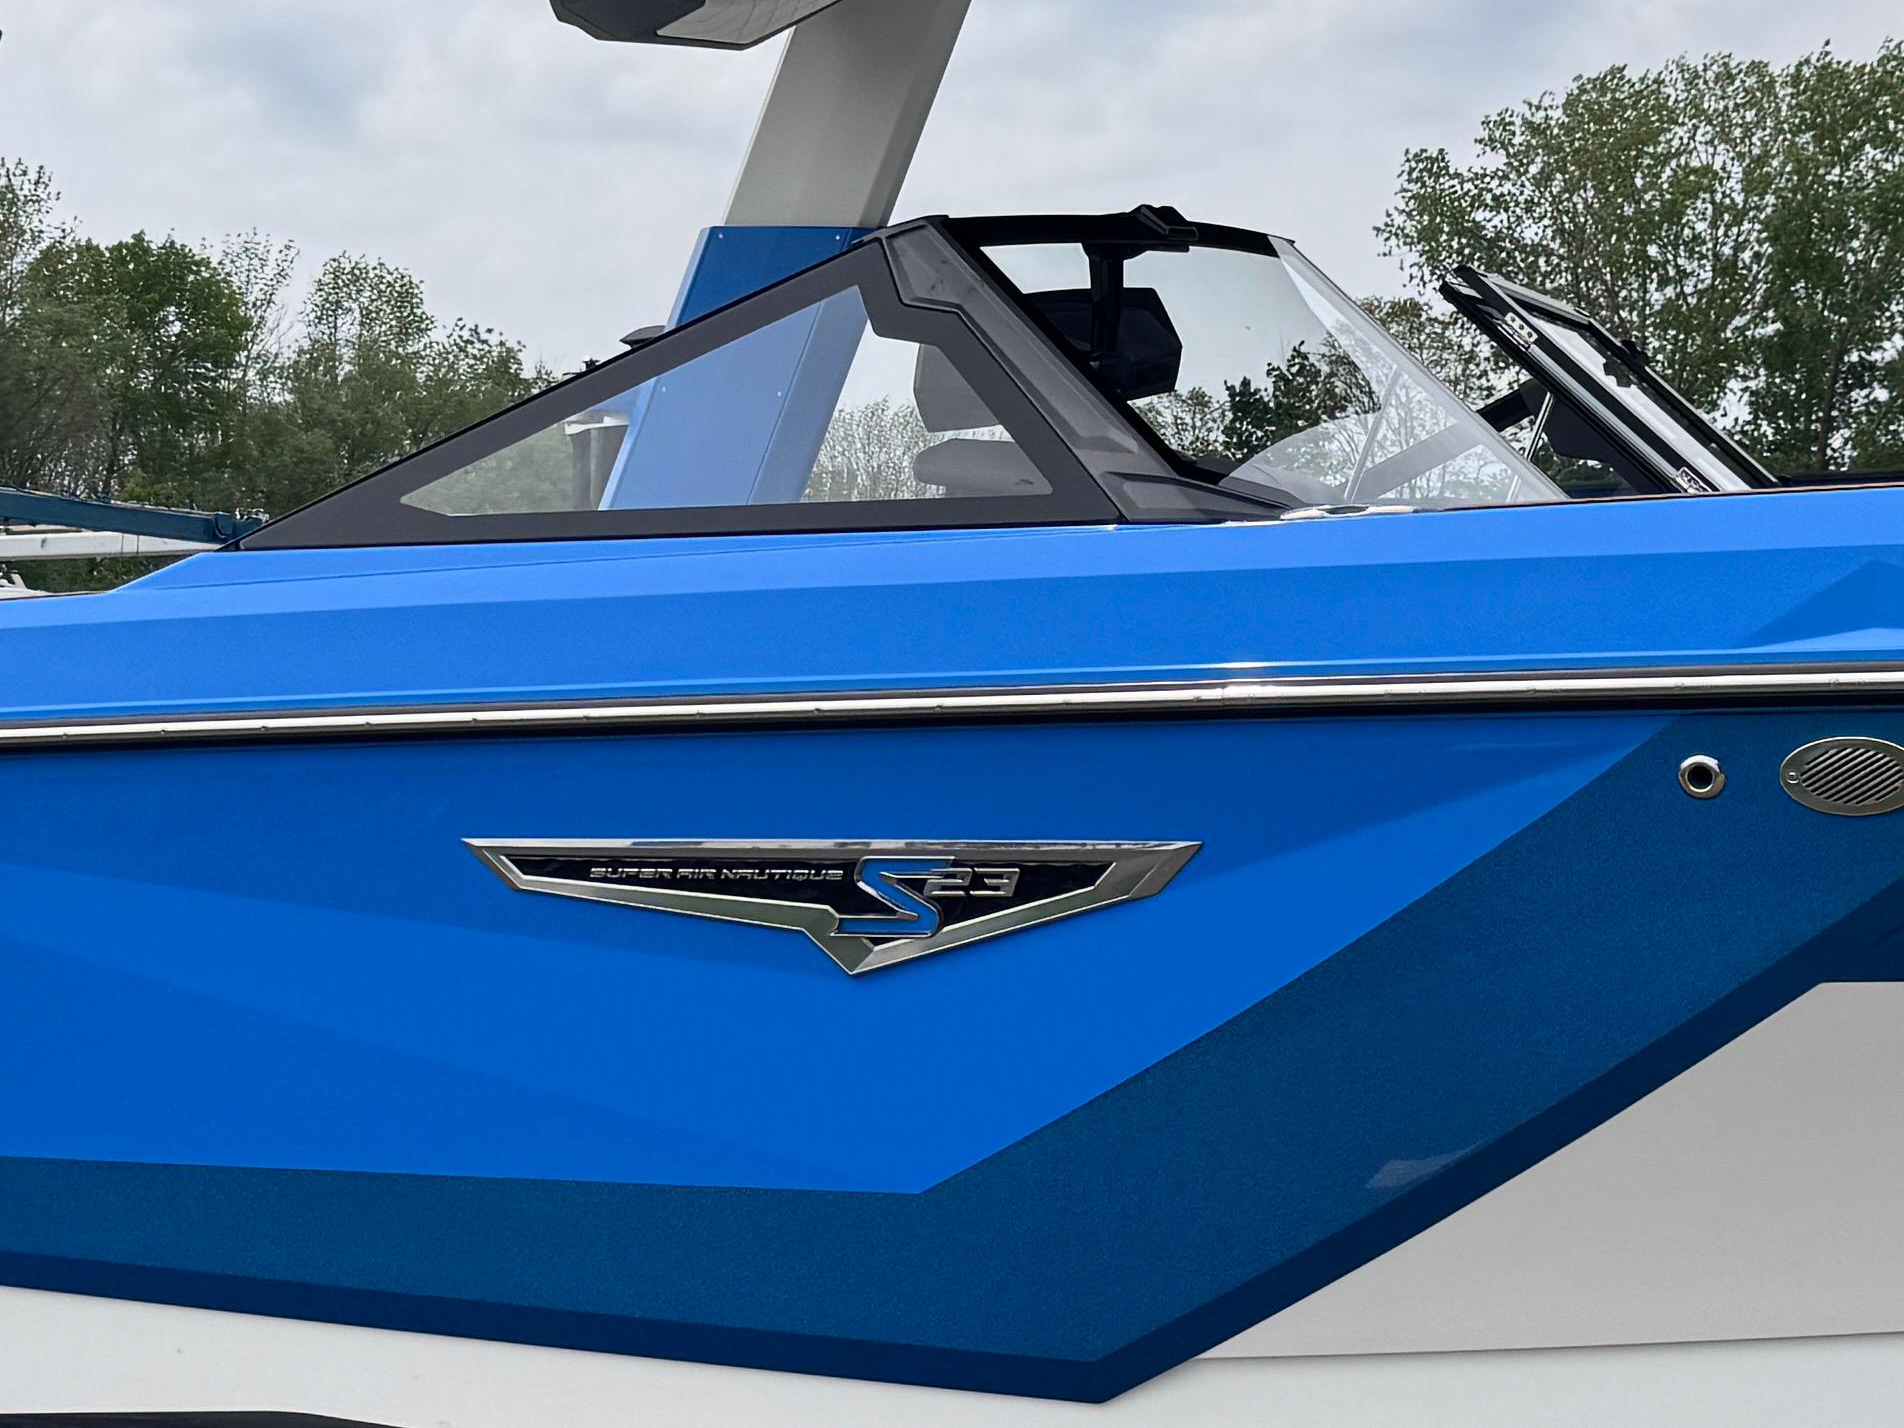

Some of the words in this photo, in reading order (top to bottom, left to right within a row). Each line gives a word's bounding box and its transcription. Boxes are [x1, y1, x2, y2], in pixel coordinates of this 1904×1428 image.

[589, 867, 673, 879] SUPER
[676, 868, 717, 880] AIR
[720, 868, 844, 882] NAUTIQUE
